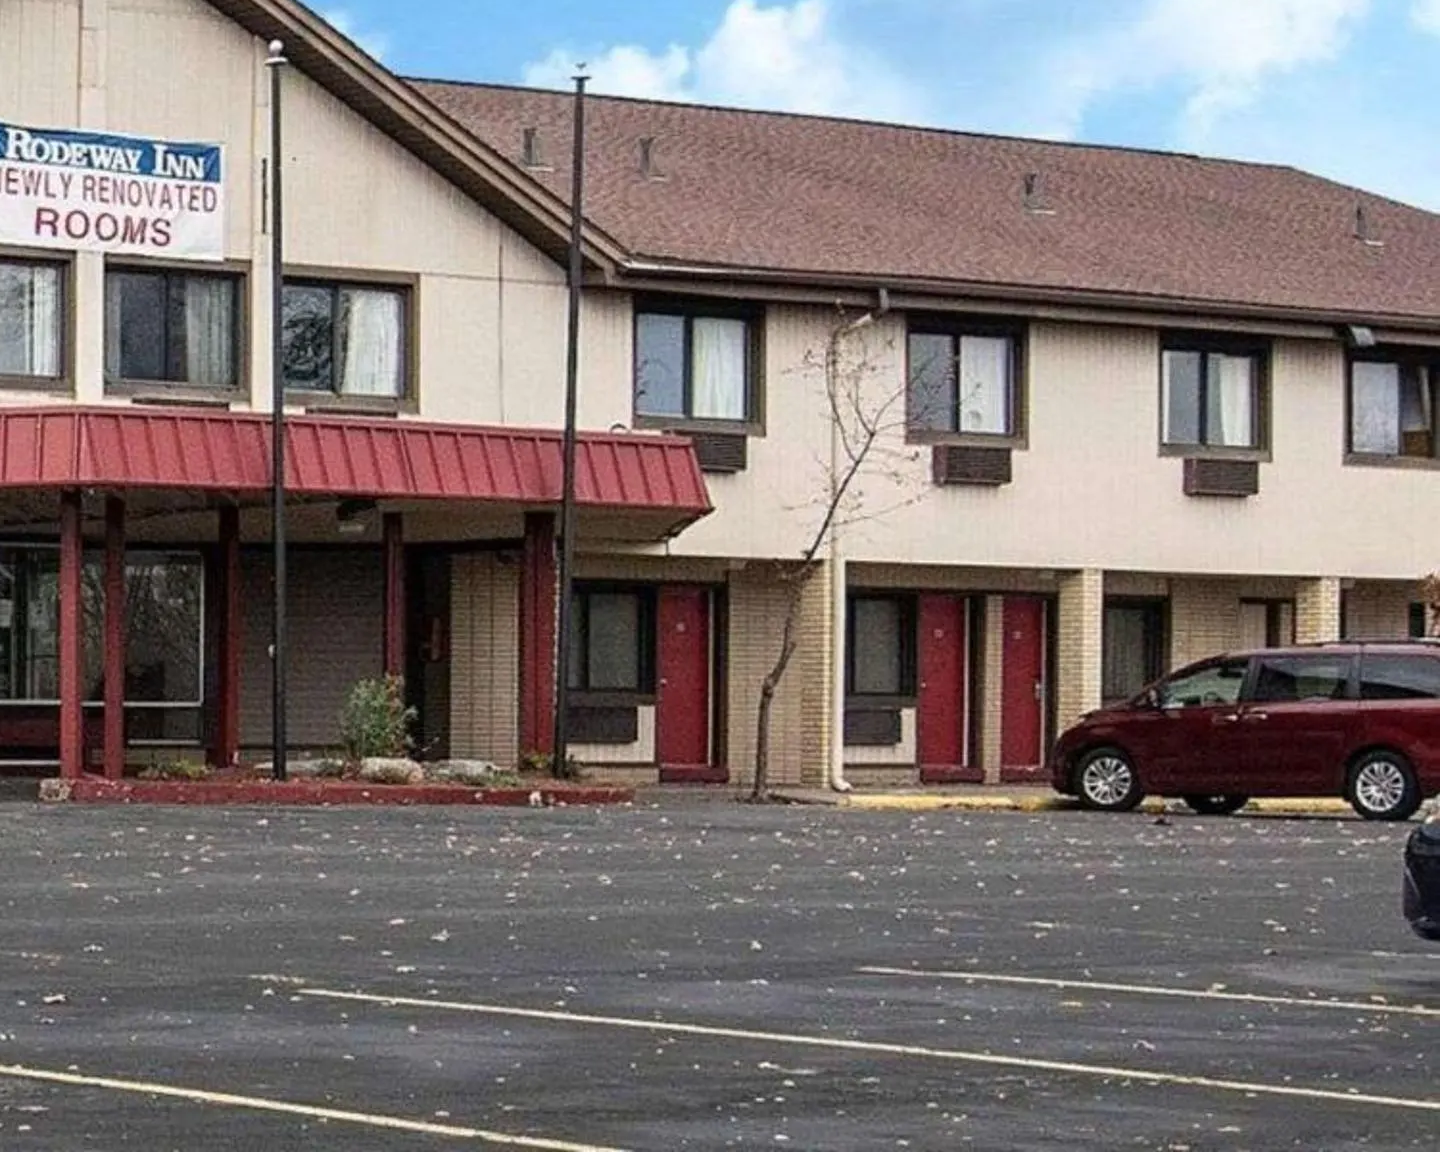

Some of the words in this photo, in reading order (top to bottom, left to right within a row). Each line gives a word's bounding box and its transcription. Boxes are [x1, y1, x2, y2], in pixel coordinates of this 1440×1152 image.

[3, 127, 142, 172] RODEWAY
[153, 144, 206, 179] INN
[82, 174, 217, 212] RENOVATED
[34, 207, 172, 246] ROOMS
